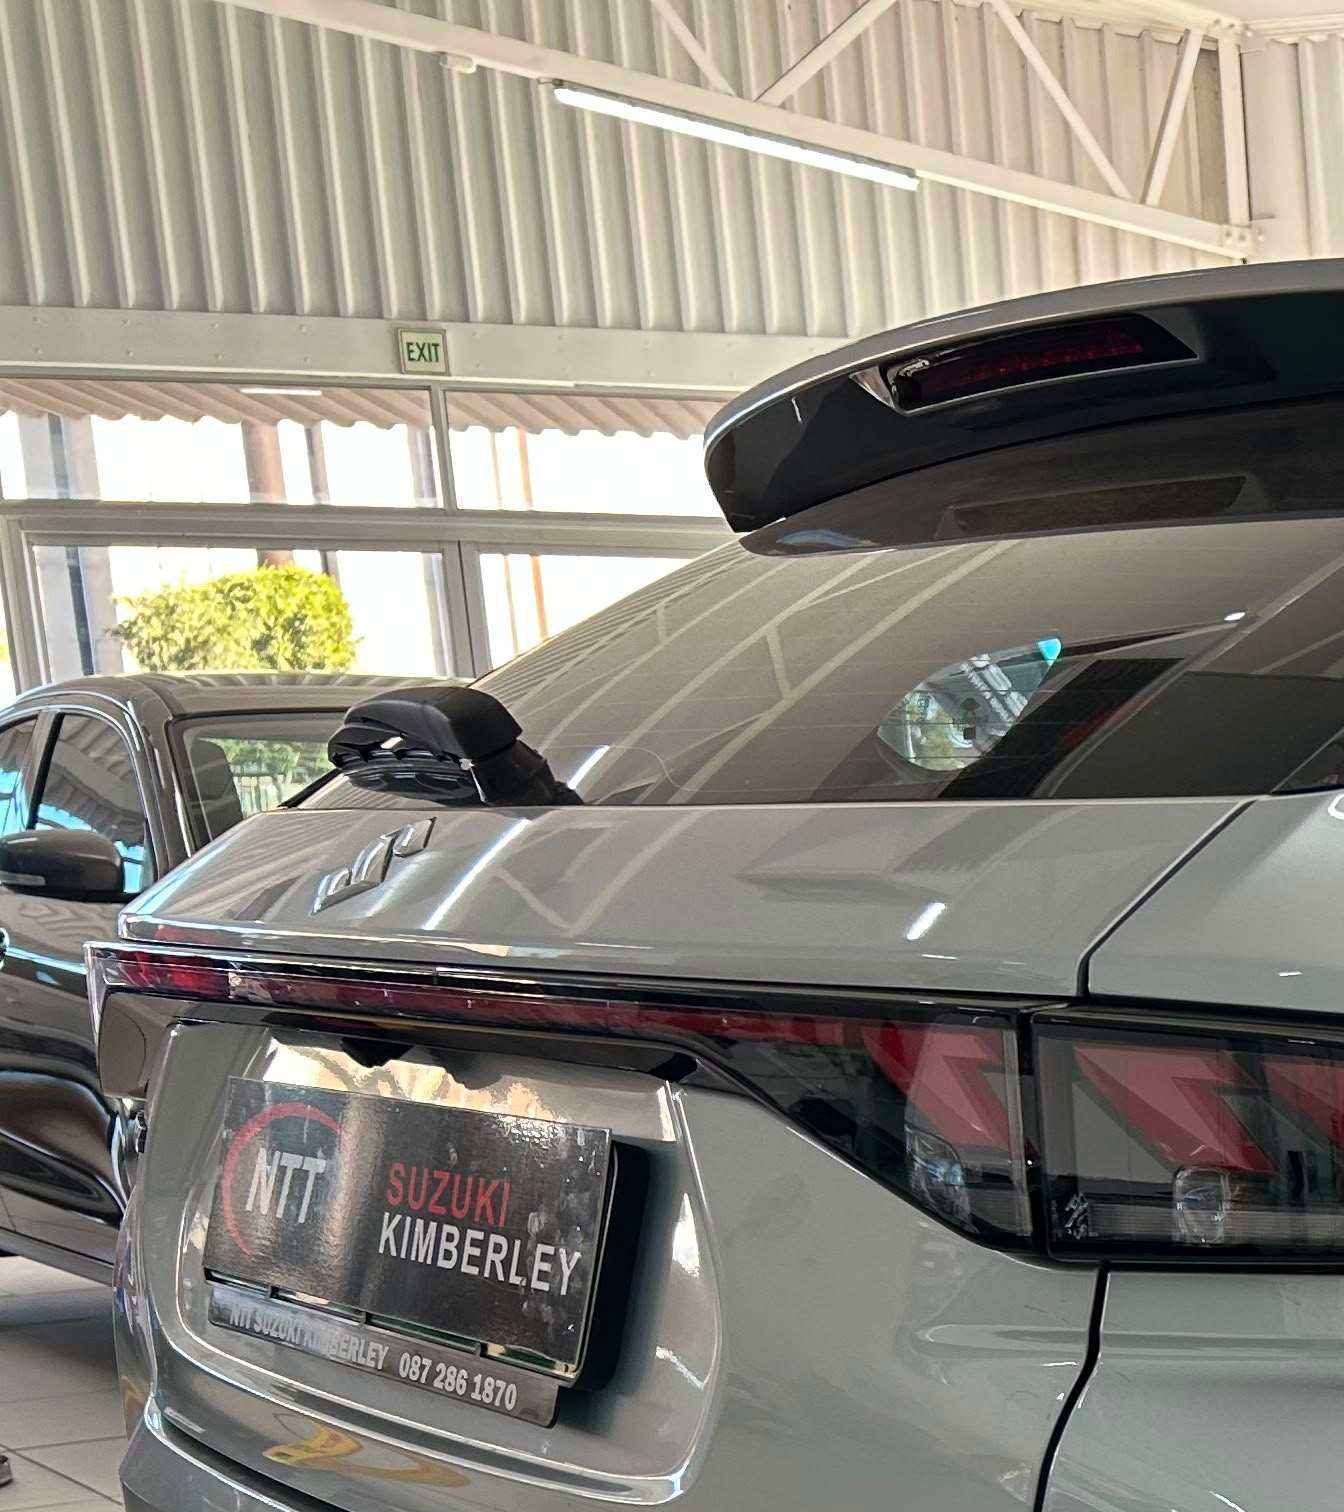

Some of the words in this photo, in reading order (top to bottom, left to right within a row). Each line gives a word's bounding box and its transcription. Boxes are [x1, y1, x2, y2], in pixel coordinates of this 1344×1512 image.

[406, 342, 440, 362] EXIT
[246, 1147, 326, 1224] NTT
[386, 1161, 513, 1228] SUZUKI
[378, 1211, 582, 1296] KIMBERLEY
[253, 1309, 304, 1345] SUZUKI
[399, 1351, 433, 1385] 087
[432, 1362, 469, 1397] 286
[470, 1373, 518, 1412] 1870
